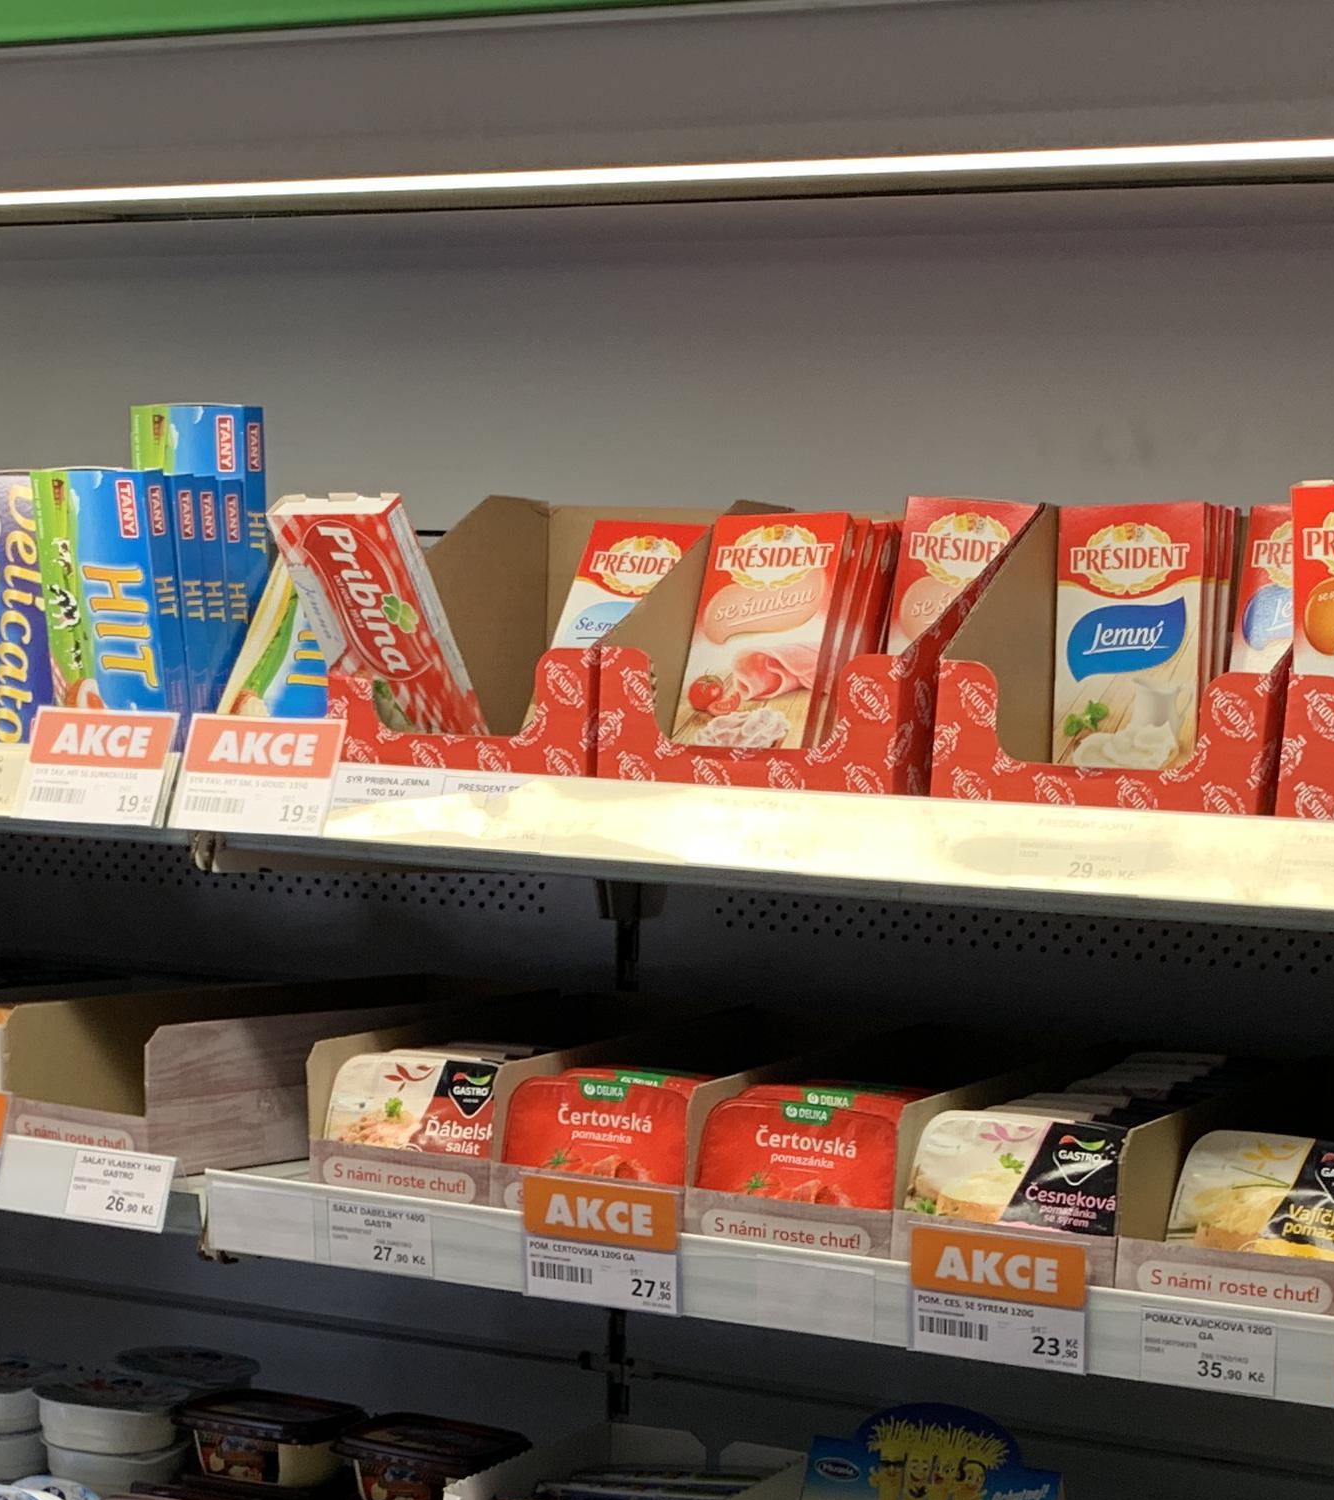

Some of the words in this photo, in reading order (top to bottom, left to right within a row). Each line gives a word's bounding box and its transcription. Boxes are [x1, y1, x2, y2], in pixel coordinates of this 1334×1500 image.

[218, 418, 233, 471] TANY
[118, 483, 137, 537] TANY
[716, 542, 832, 573] PRÉSIDENT
[1071, 543, 1189, 572] PRÉSIDENT
[316, 524, 410, 674] Pribina
[84, 563, 158, 689] HIT
[1089, 621, 1164, 653] Jemný
[51, 724, 151, 759] AKCE
[208, 733, 316, 766] AKCE
[452, 1085, 490, 1098] GASTRO
[596, 1084, 624, 1098] DELIKA
[557, 1104, 652, 1134] Čertovská
[445, 1140, 480, 1156] salát
[572, 1128, 632, 1145] pomazánka
[755, 1126, 857, 1159] Čertovská
[770, 1153, 835, 1170] pomazánka
[1058, 1148, 1102, 1163] GASTRO
[333, 1164, 343, 1179] S
[346, 1164, 383, 1185] námi
[387, 1171, 425, 1190] roste
[428, 1173, 466, 1195] chuť!
[1025, 1183, 1116, 1212] Česneková
[544, 1192, 654, 1237] AKCE
[373, 1244, 410, 1264] 27,90
[413, 1253, 426, 1265] Kč
[935, 1246, 1059, 1293] AKCE
[1033, 1335, 1059, 1356] 23
[1066, 1338, 1079, 1348] Kč
[1199, 1331, 1214, 1341] GA
[1197, 1359, 1243, 1381] 35,90
[1248, 1371, 1265, 1383] Kč
